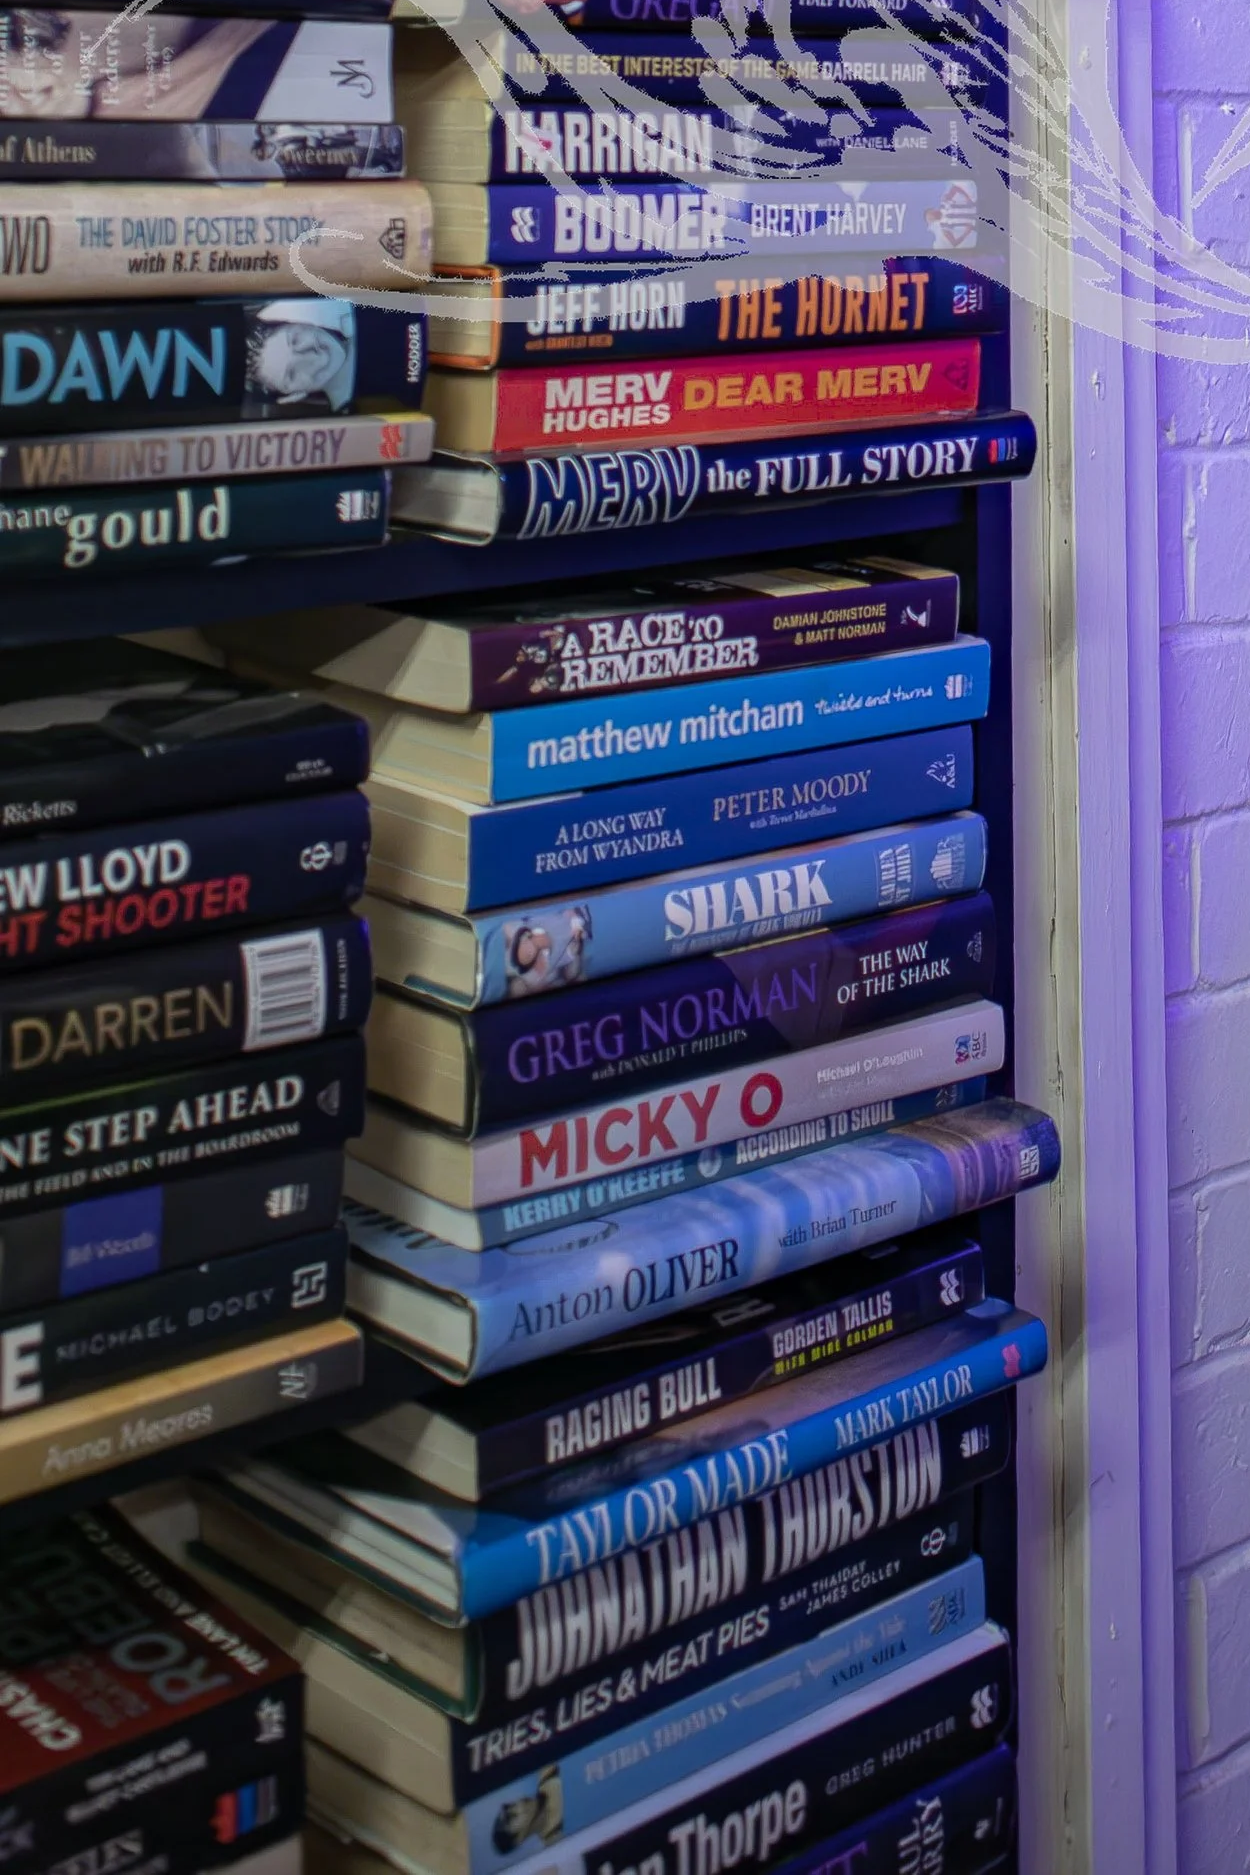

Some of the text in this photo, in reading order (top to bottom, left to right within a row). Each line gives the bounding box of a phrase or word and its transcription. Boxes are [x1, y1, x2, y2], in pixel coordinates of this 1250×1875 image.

[505, 110, 714, 173] HARRIGAN
[526, 272, 930, 341] JEFF HORN THE HORNET
[2, 327, 228, 405] DAWN
[544, 371, 673, 412] MERV
[684, 362, 932, 412] DEAR MERV
[543, 402, 672, 434] HUGHES
[518, 437, 979, 540] MERV the FULL STORY
[64, 485, 230, 567] gould
[528, 697, 804, 769] matthew mitcham
[712, 770, 872, 821] PETER MOODY
[57, 839, 191, 901] LLOYD
[664, 859, 832, 941] SHARK
[56, 874, 251, 947] SHOOTER
[838, 957, 951, 1005] OF THE SHARK
[859, 941, 928, 976] THE WAY
[11, 980, 234, 1071] DARREN
[519, 1071, 784, 1189] MICKY O
[621, 1239, 741, 1313] OLIVER
[772, 1291, 893, 1357] GORDEN TALLIS
[546, 1356, 722, 1464] RAGING BULL
[834, 1364, 974, 1450] MARK TAYLOR
[527, 1429, 794, 1566] TAYLOR MADE
[668, 1781, 808, 1868] Thorpe
